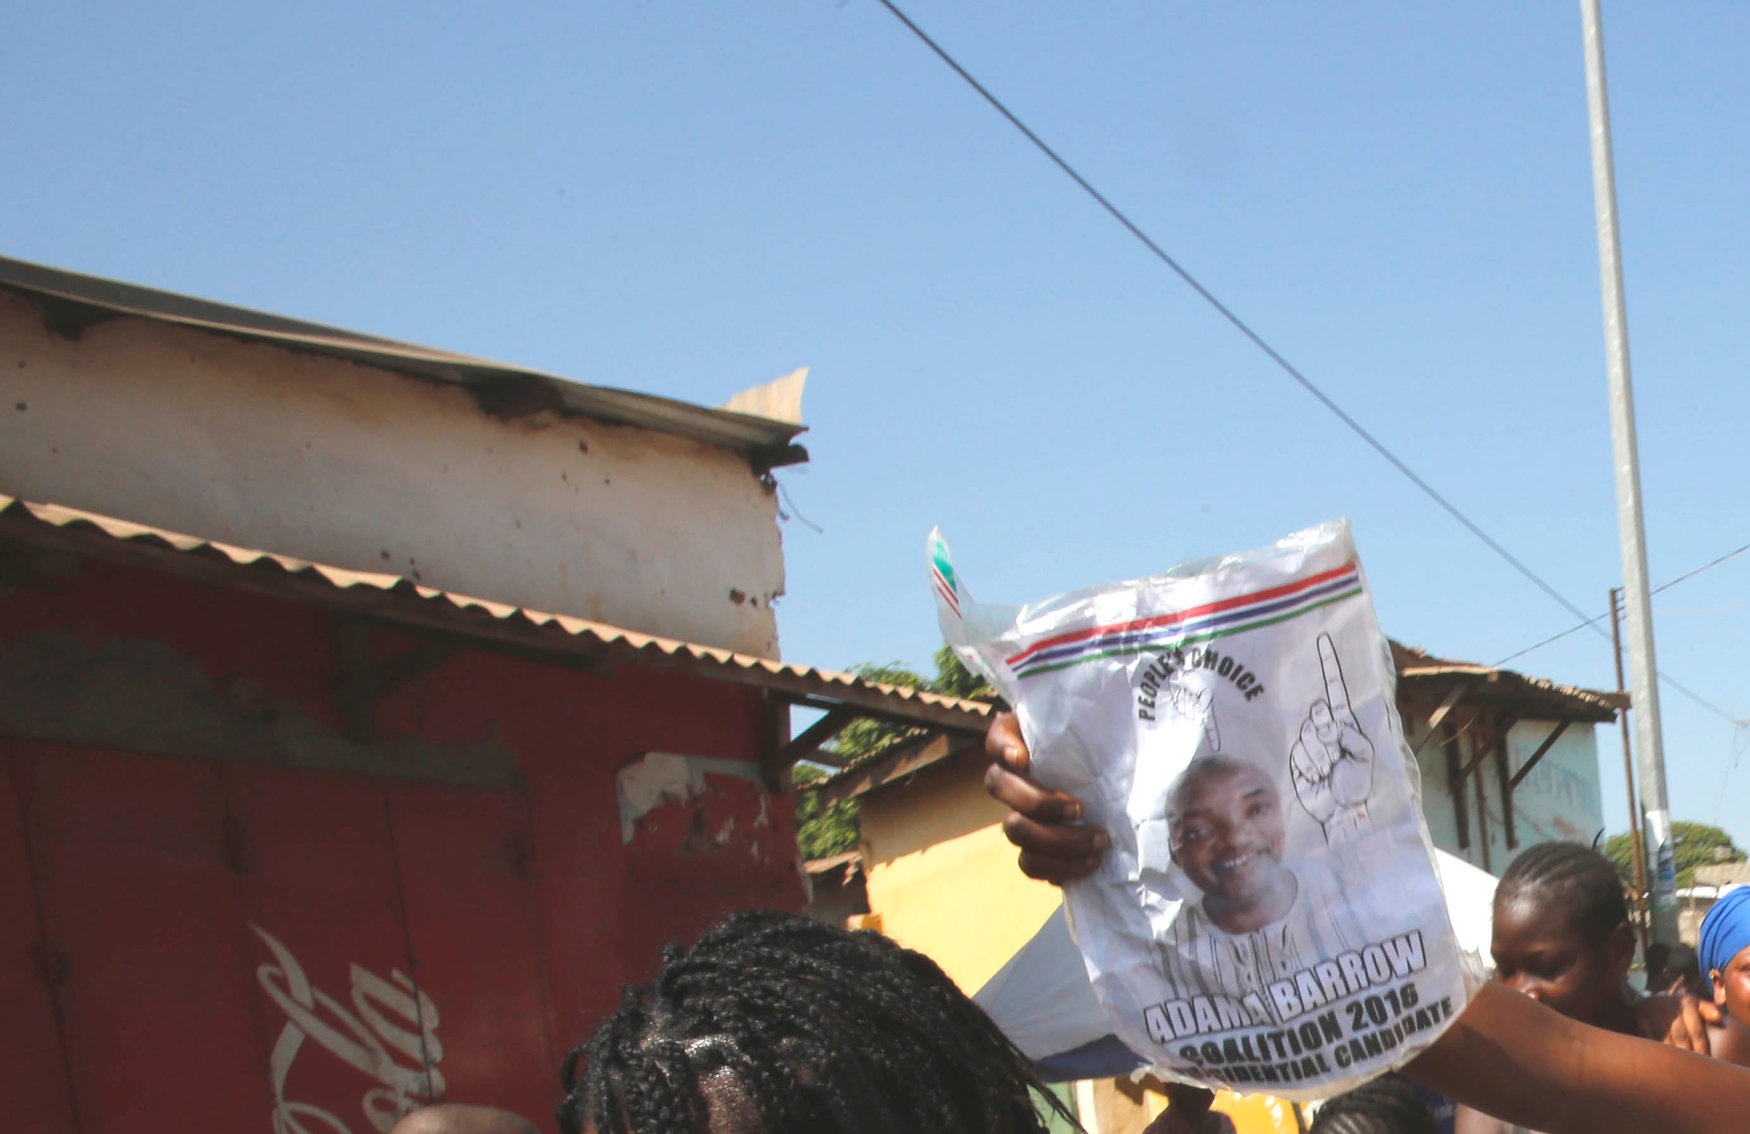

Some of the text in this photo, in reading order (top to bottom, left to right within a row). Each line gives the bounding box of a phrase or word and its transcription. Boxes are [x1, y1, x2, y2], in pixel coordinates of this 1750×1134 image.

[1191, 646, 1265, 702] CHOICE
[1144, 929, 1428, 1044] ADAMA BARROW
[1178, 982, 1419, 1067] COALITION 2016
[1170, 996, 1452, 1084] SIDENTIAL CANDIDATE
